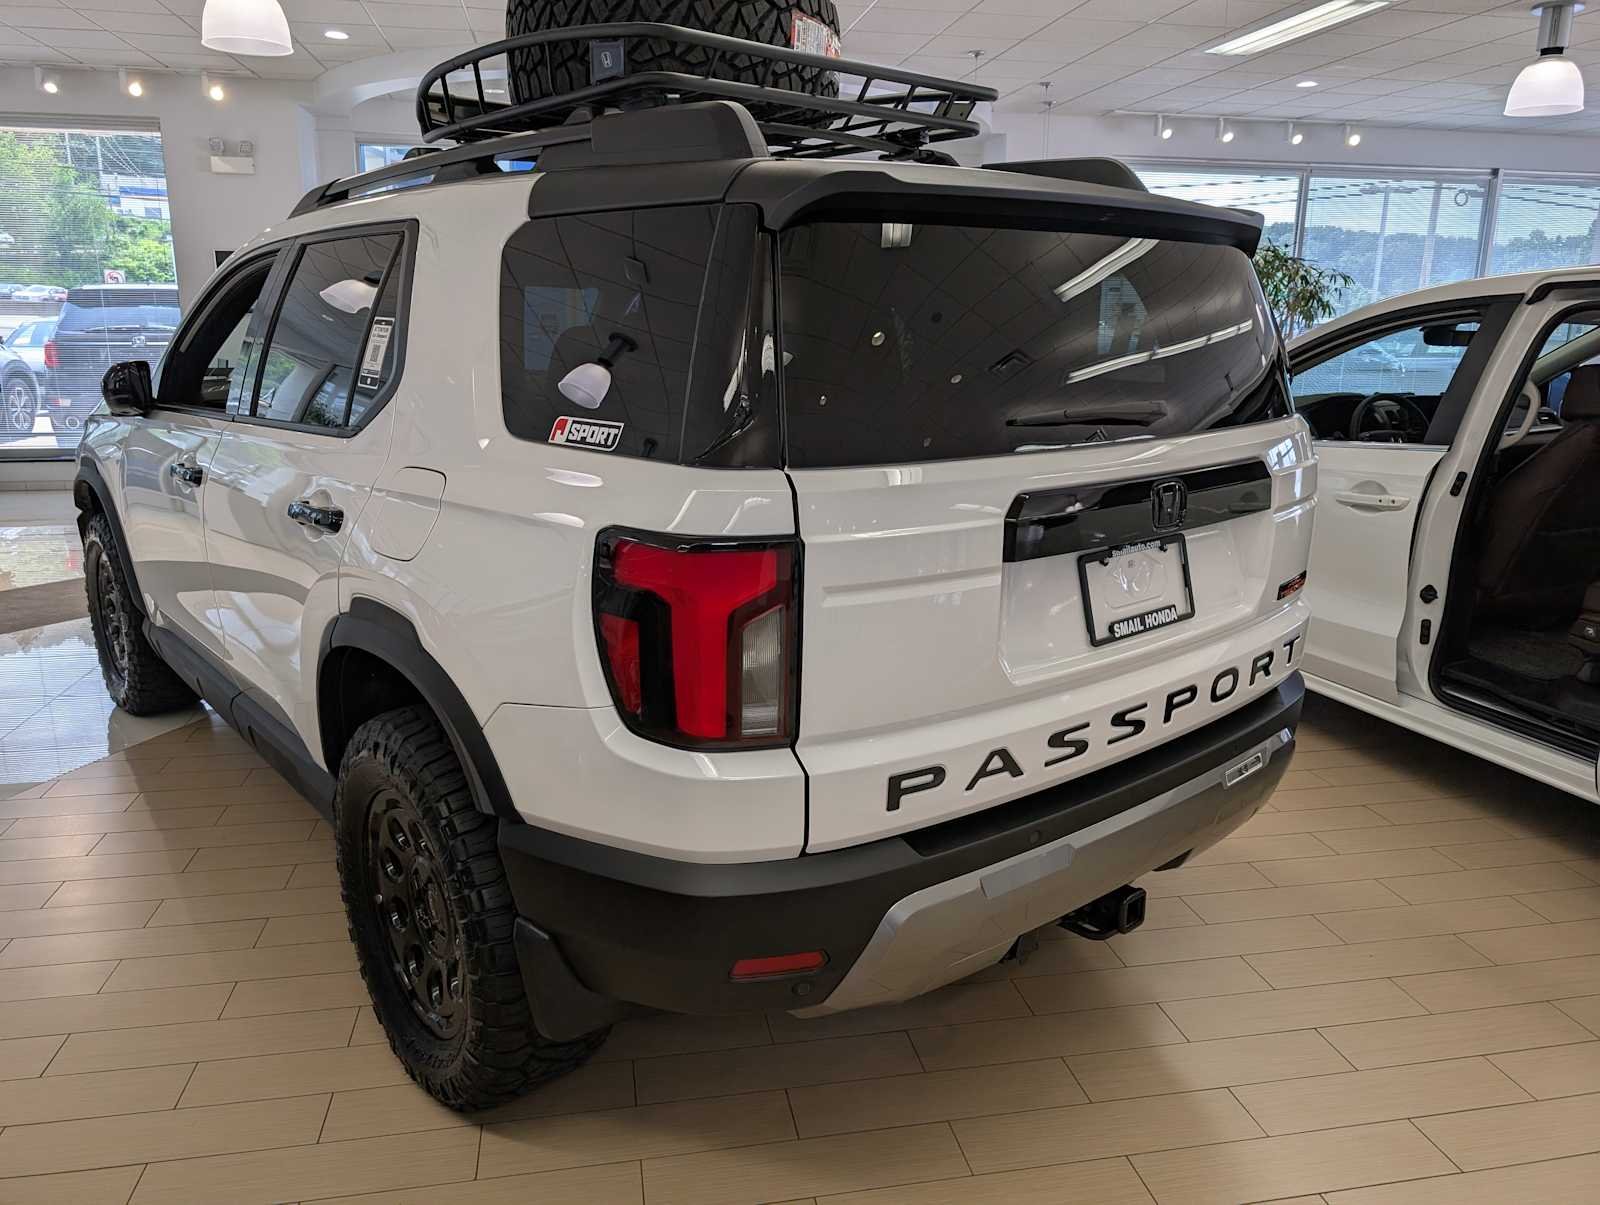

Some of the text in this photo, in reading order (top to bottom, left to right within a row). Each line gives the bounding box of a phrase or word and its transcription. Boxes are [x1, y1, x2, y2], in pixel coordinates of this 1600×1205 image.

[1113, 606, 1178, 638] SMAIL HONDA
[885, 636, 1301, 812] PASSPORT
